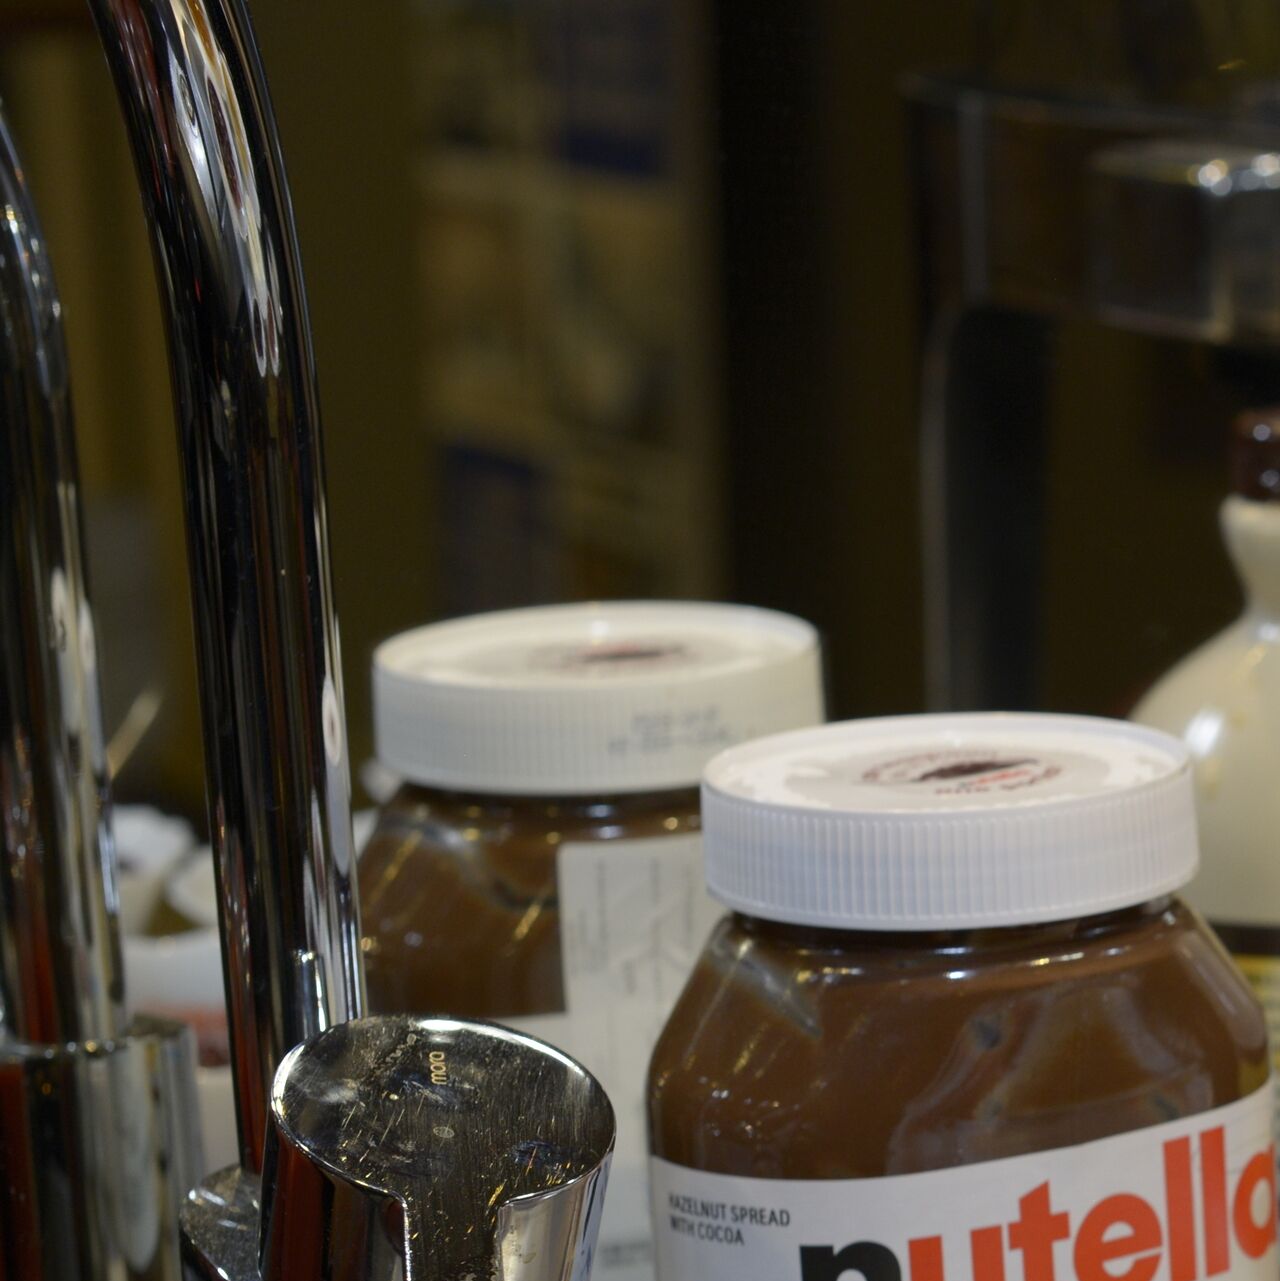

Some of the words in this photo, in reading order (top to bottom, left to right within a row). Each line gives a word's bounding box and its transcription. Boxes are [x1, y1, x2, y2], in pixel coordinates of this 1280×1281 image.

[429, 1051, 447, 1085] mora
[729, 1204, 791, 1228] SPREAD
[697, 1220, 746, 1246] COCOA
